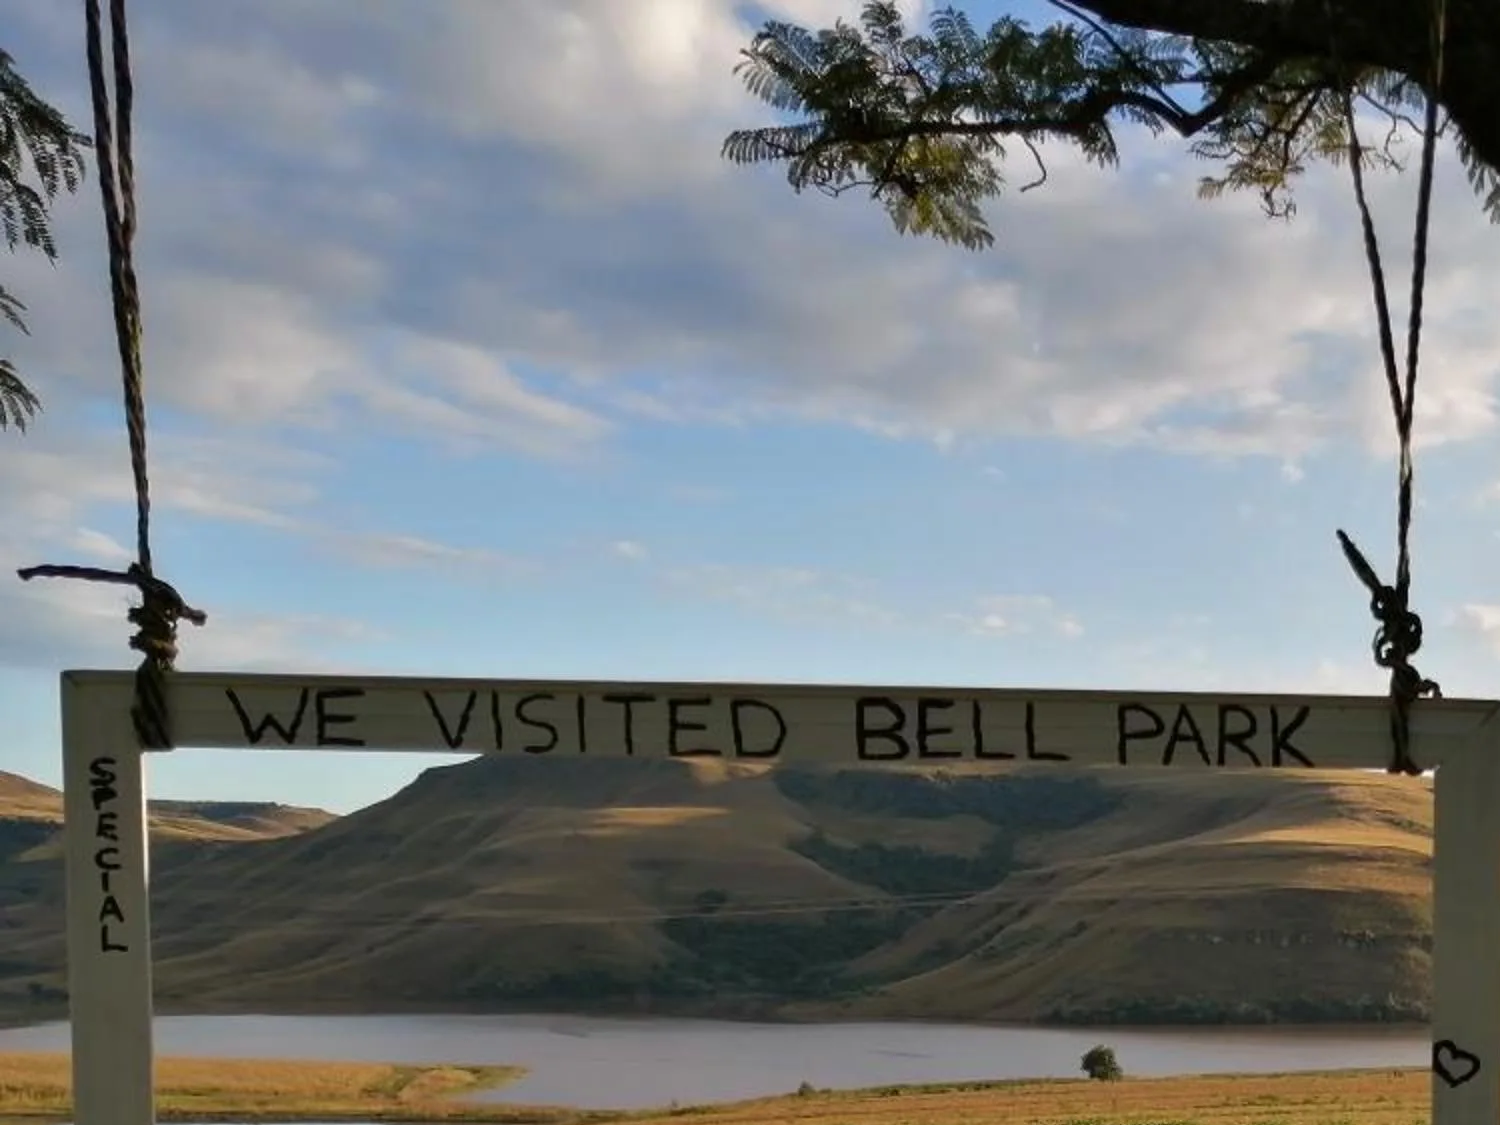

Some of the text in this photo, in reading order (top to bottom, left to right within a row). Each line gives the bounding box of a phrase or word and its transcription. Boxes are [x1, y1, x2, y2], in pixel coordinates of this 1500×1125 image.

[226, 687, 1315, 767] WE VISITED BELL PARK
[88, 757, 129, 952] SPECIAL
